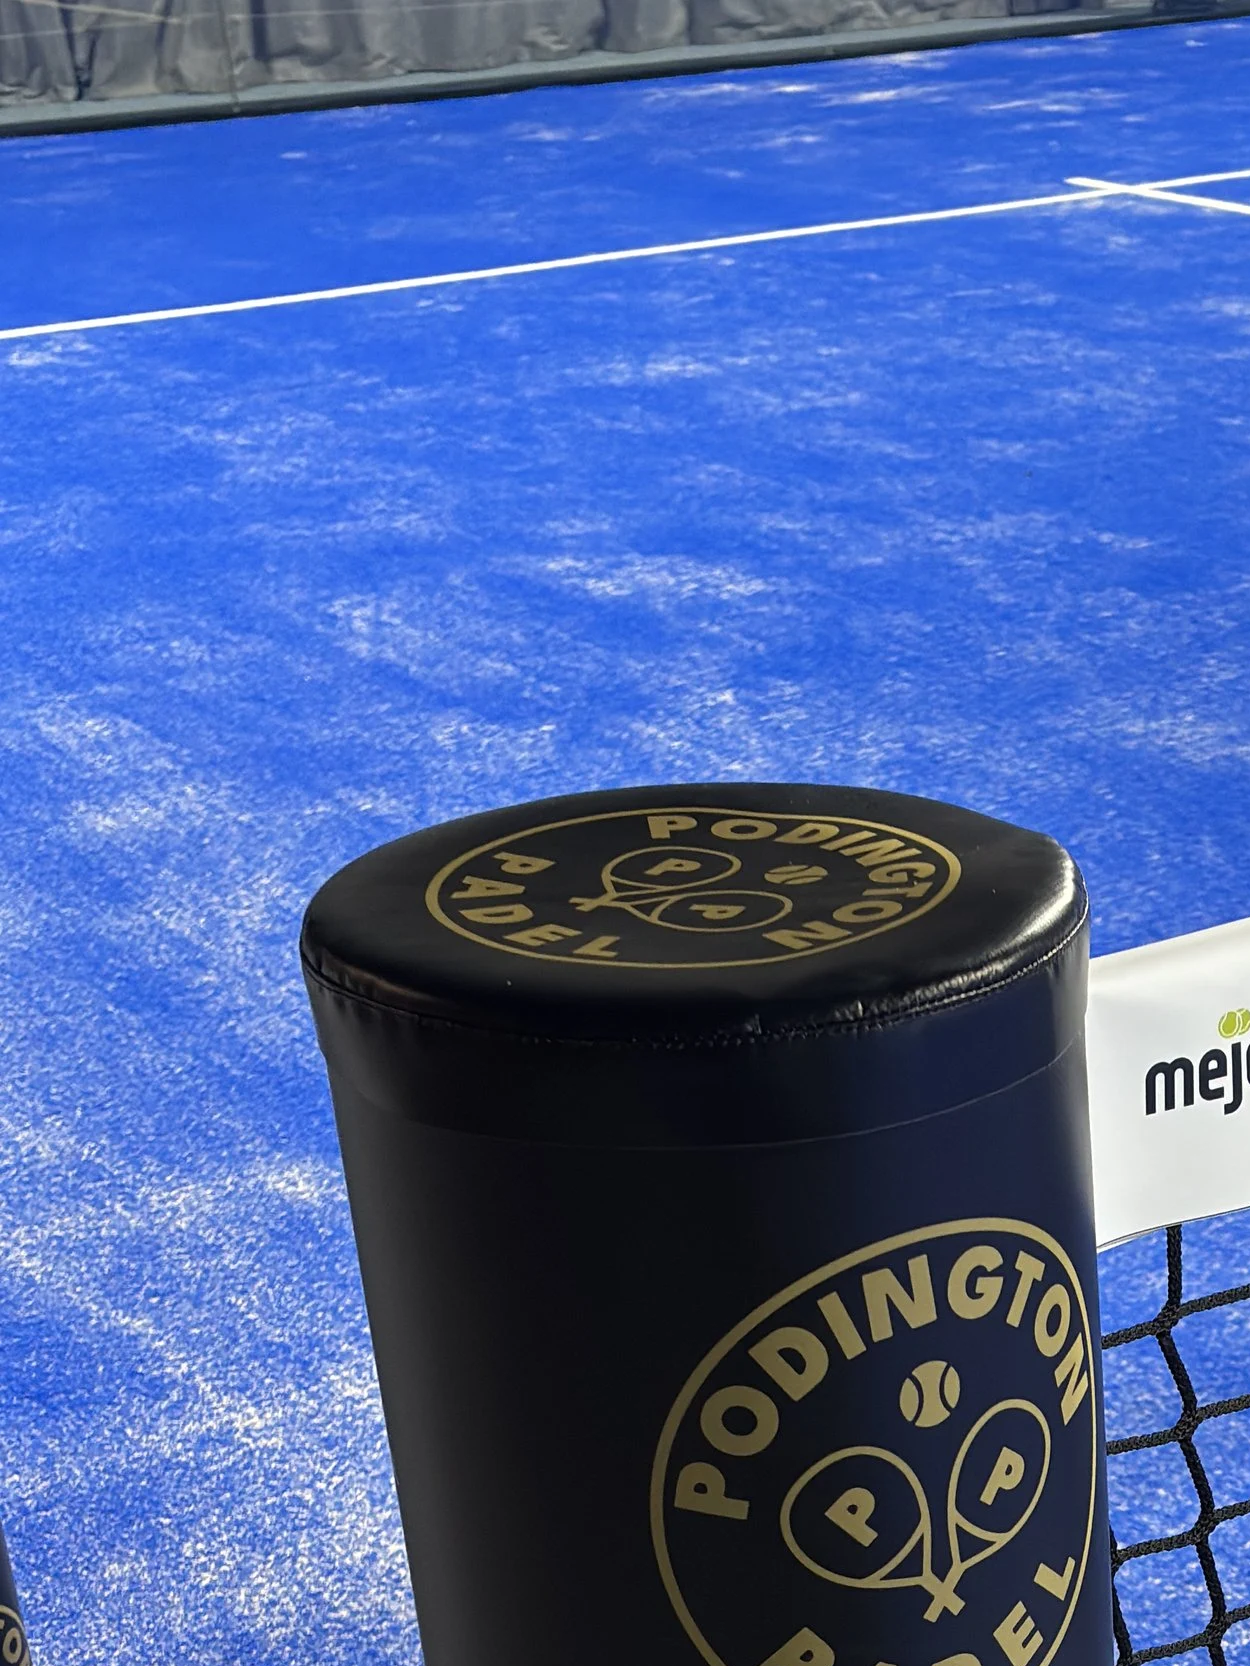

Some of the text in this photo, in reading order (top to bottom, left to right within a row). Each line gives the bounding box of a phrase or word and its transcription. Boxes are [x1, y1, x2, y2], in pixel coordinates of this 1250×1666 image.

[451, 852, 621, 959] PADEL
[647, 815, 936, 951] PODINGTON
[674, 1245, 1089, 1520] PODINGTON
[824, 1447, 1025, 1548] P P
